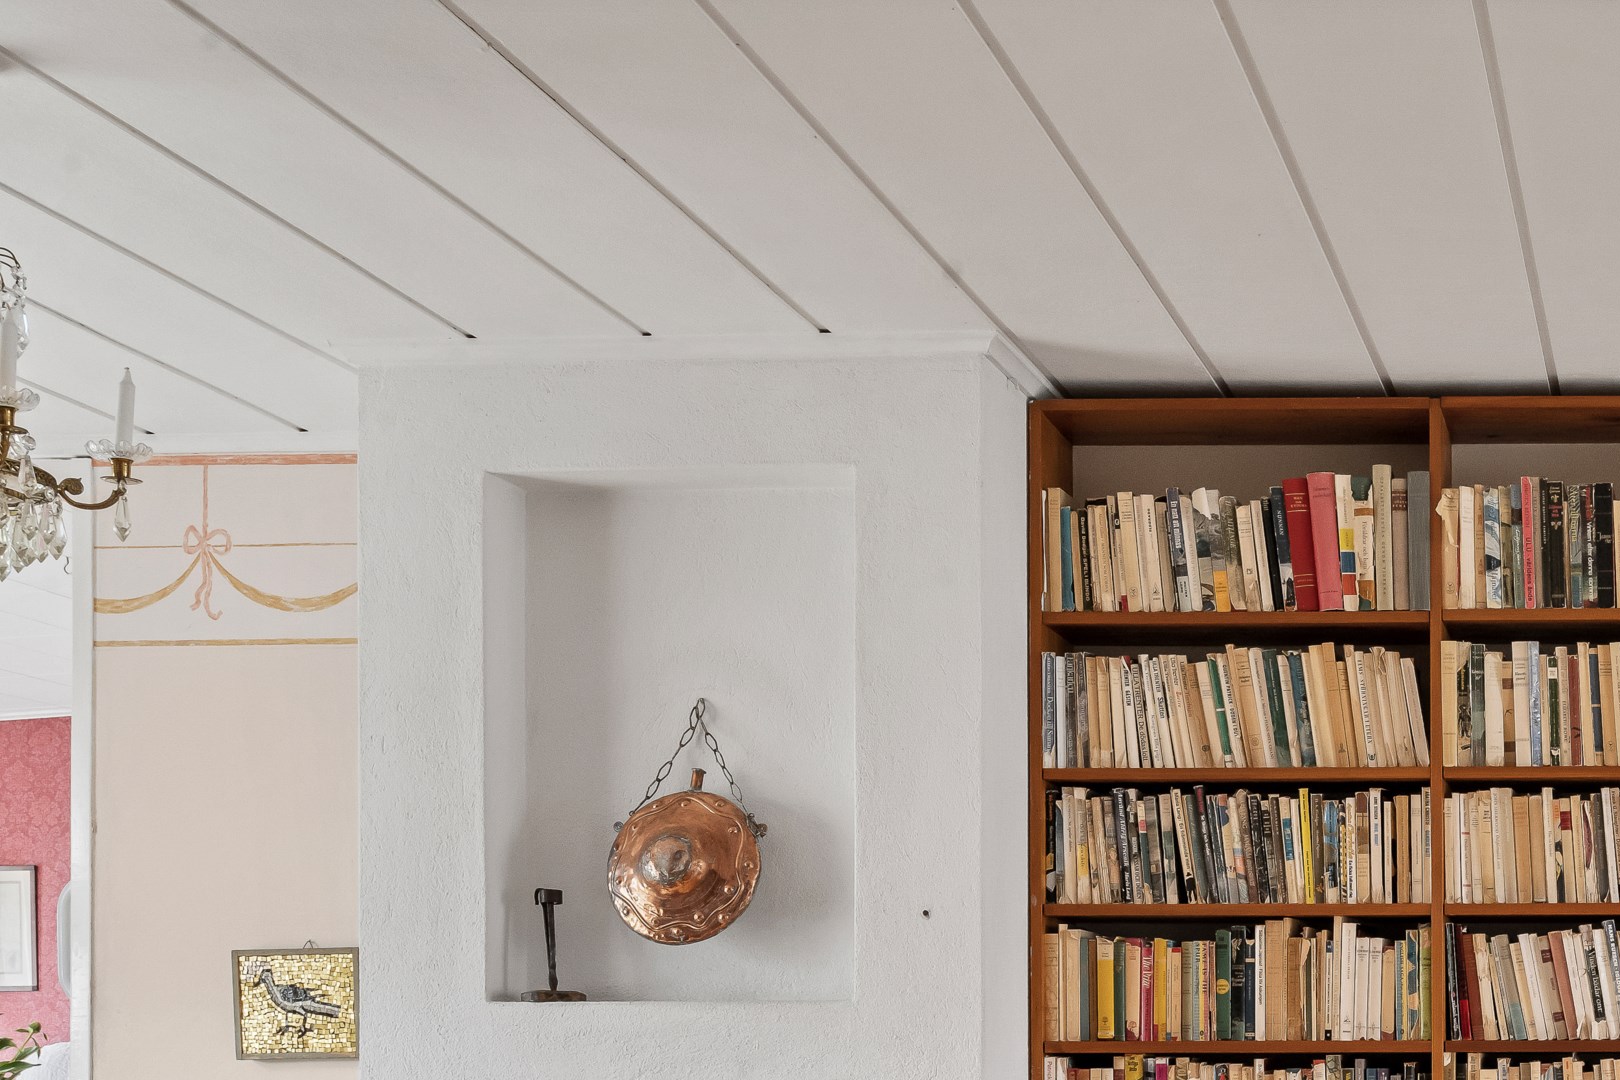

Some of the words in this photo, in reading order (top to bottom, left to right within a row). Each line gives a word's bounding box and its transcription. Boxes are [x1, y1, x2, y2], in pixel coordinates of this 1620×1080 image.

[1131, 666, 1139, 686] ULLA
[1133, 686, 1144, 720] TRENTER
[1157, 696, 1166, 719] Skatten
[1137, 721, 1145, 731] De
[1607, 924, 1615, 942] HANS
[1142, 956, 1153, 971] The
[1587, 950, 1599, 976] Vinden
[1142, 970, 1153, 989] Prize
